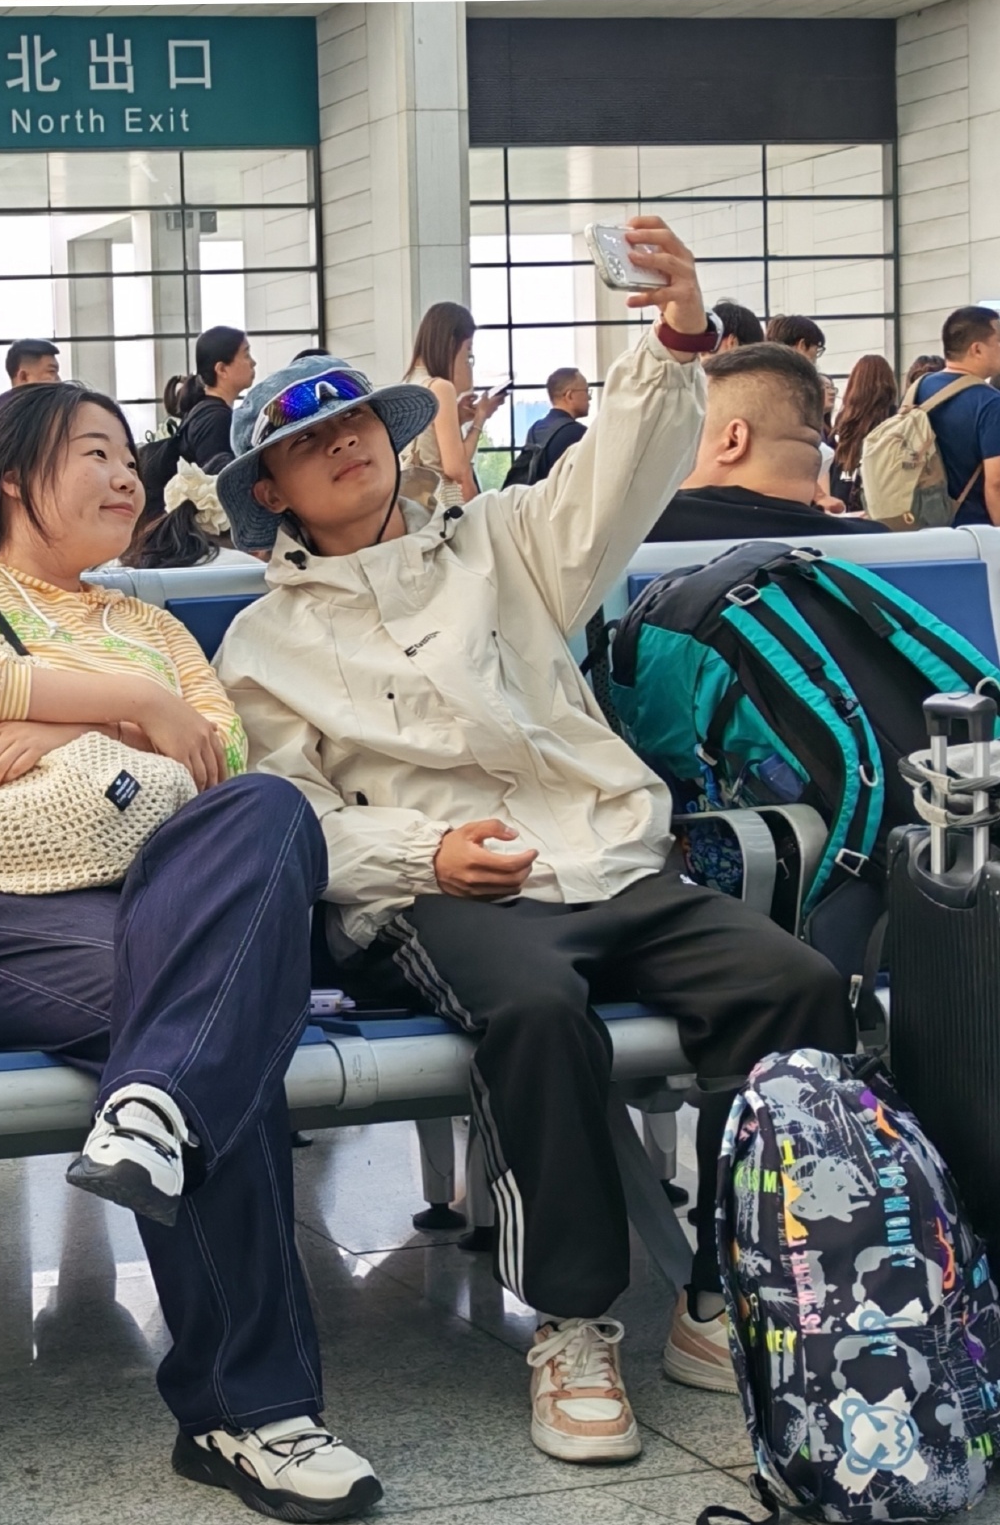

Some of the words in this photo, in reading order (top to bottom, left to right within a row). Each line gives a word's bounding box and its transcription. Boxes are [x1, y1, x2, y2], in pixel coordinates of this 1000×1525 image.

[6, 33, 211, 93] 北出口
[12, 108, 105, 133] North
[125, 108, 190, 133] Exit
[883, 1196, 915, 1268] MONEY
